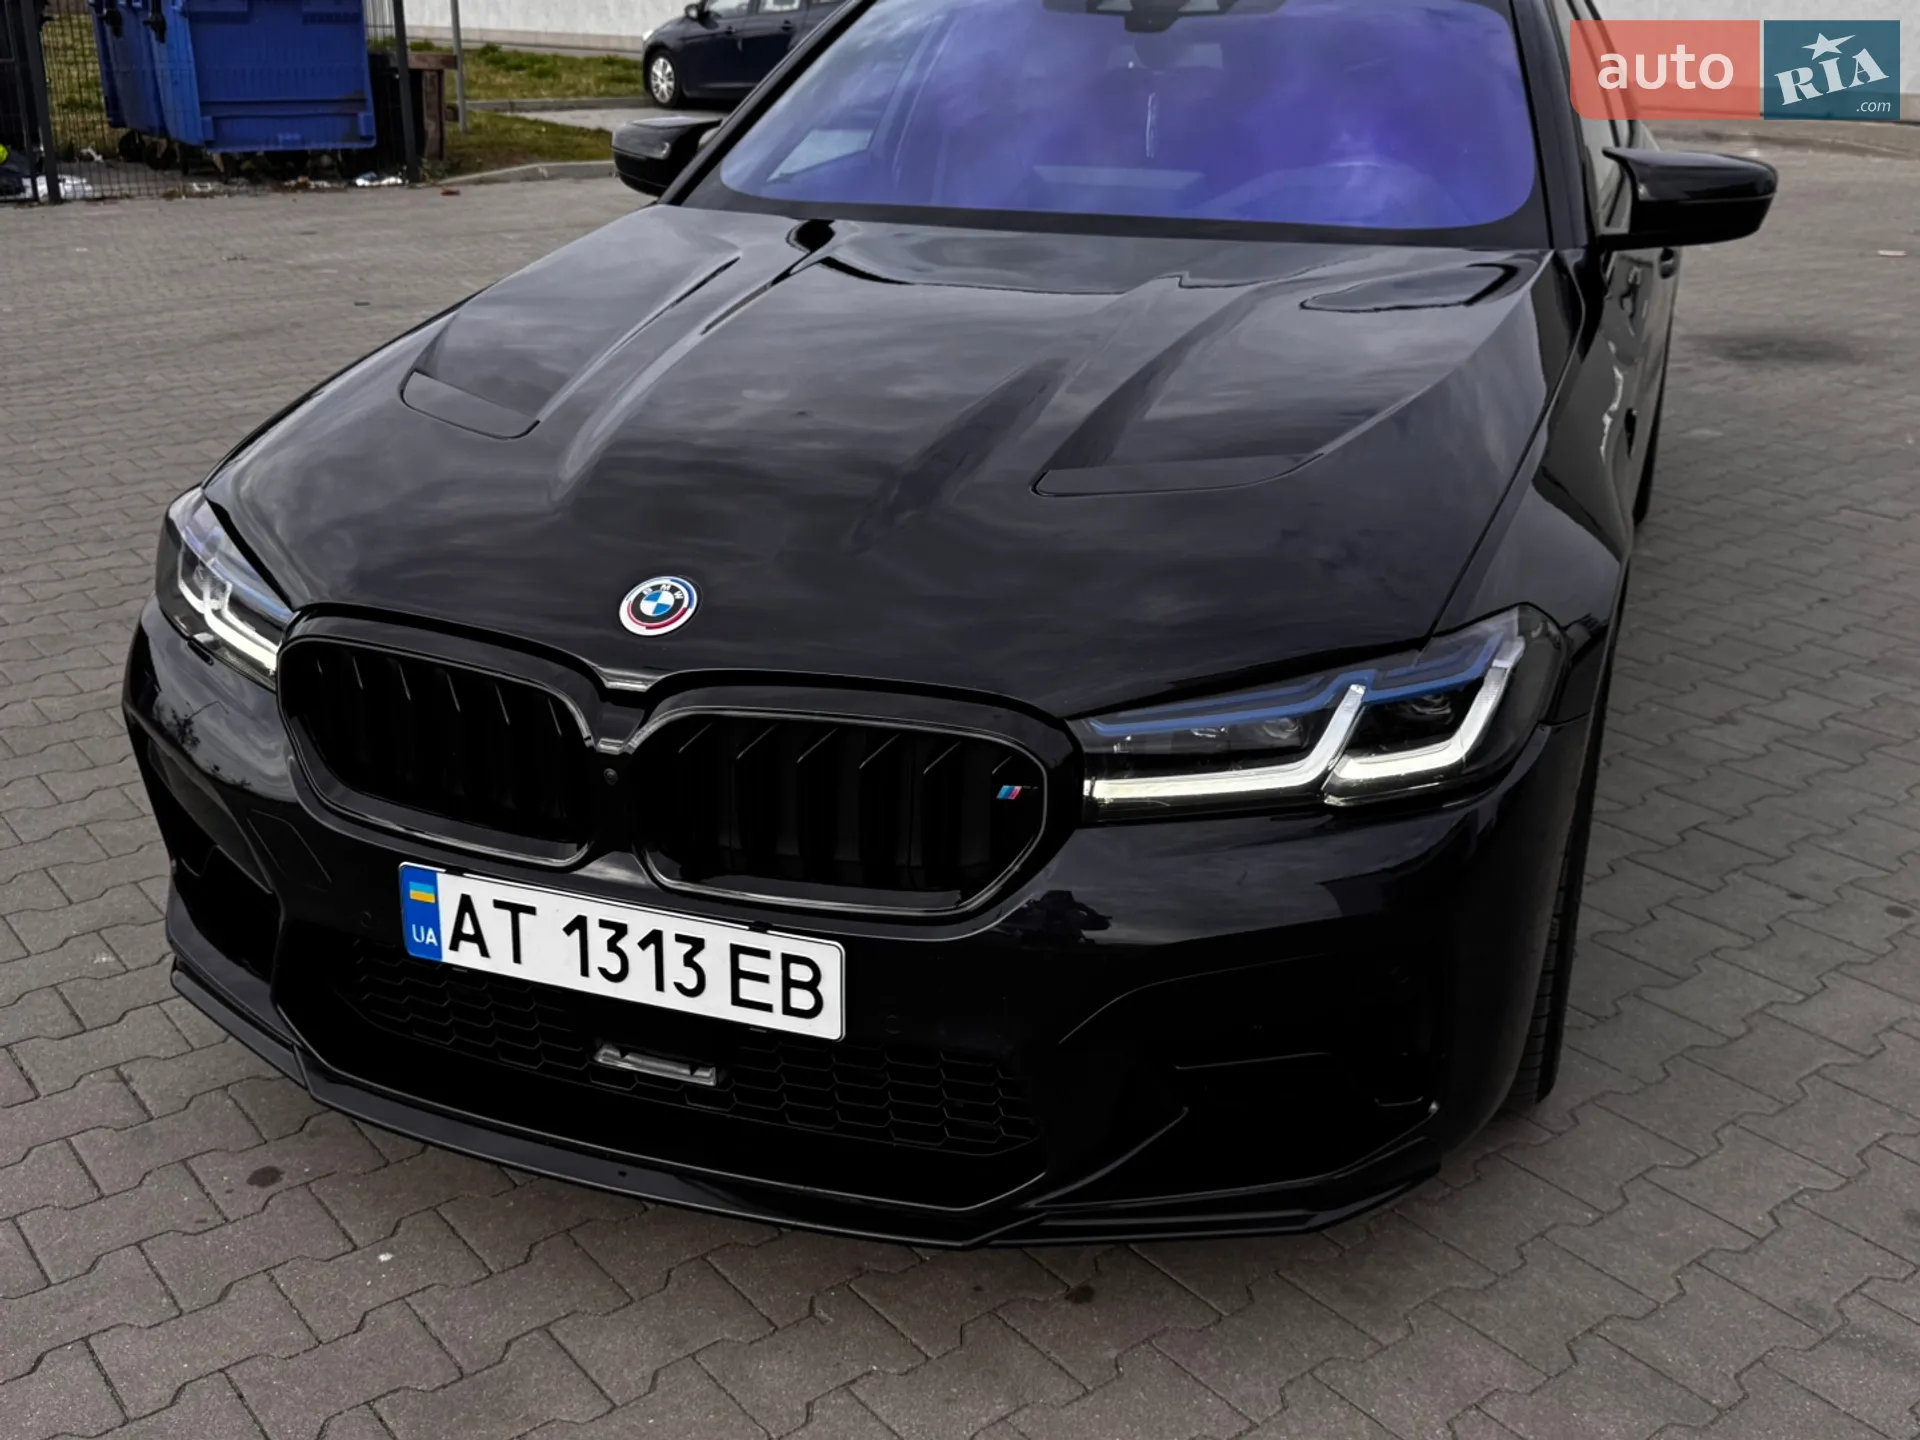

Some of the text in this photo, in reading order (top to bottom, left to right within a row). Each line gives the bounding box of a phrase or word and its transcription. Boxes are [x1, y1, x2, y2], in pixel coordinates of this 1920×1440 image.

[642, 583, 684, 600] BMW
[411, 924, 438, 947] UA
[448, 893, 824, 1020] AT 1313 EB
